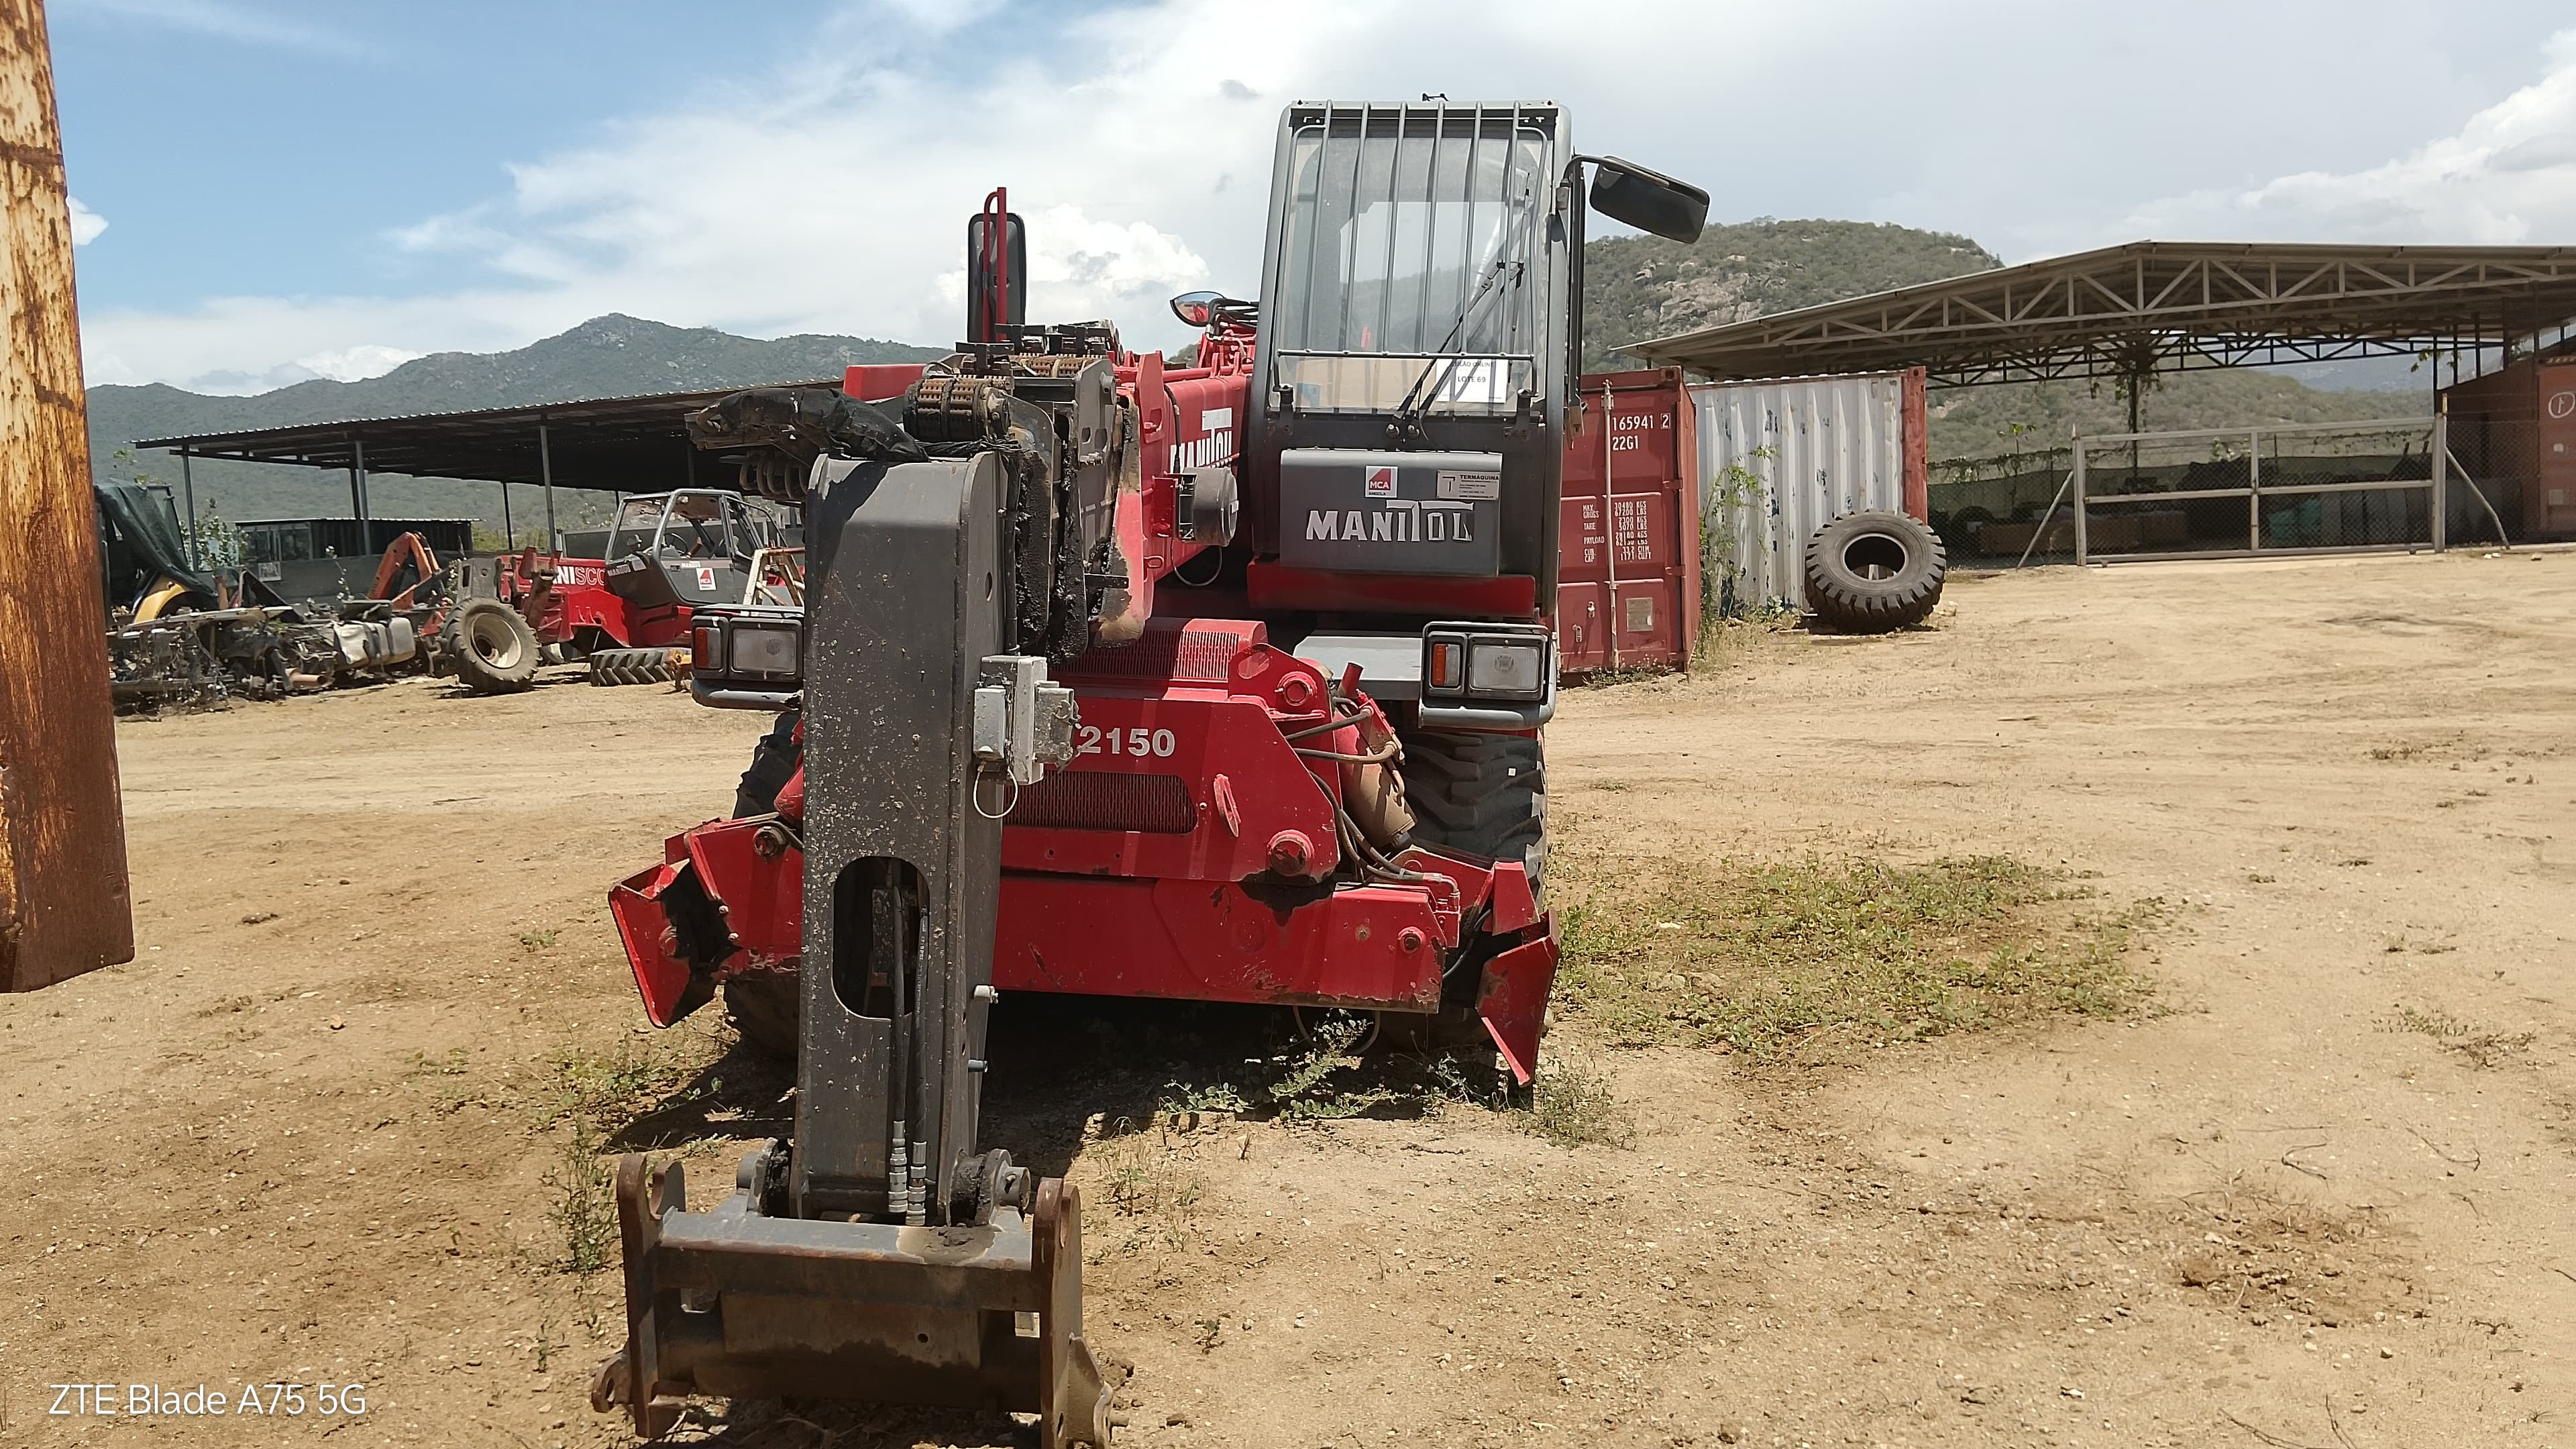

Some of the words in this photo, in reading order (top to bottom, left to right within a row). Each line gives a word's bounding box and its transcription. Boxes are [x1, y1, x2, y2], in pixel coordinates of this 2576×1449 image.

[1613, 415, 1654, 431] 165941
[1612, 435, 1639, 451] 22G1
[1370, 481, 1389, 489] MCA
[1636, 500, 1646, 509] KGS
[1583, 511, 1599, 519] GROSS
[1080, 726, 1175, 757] 2150
